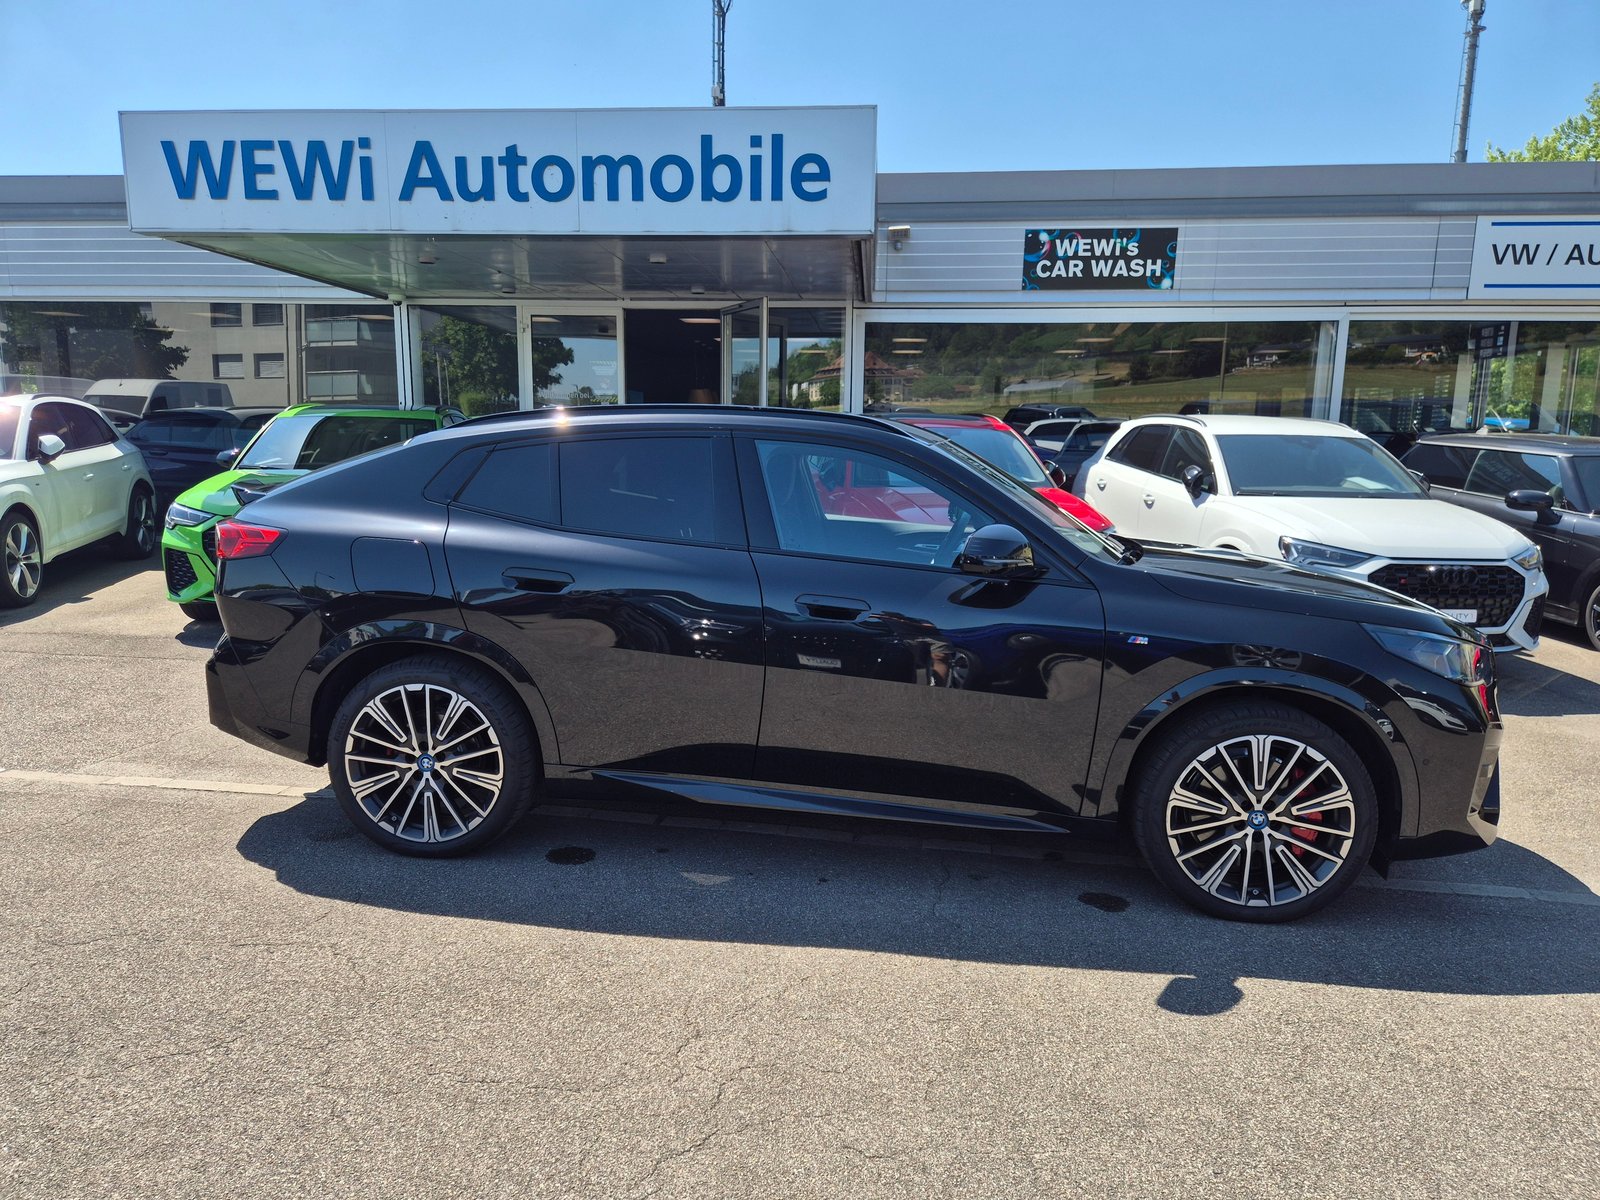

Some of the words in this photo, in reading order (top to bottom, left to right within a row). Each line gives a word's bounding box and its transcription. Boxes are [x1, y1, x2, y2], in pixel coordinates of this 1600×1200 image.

[160, 136, 375, 201] WEWi
[398, 133, 832, 203] Automobile
[1055, 237, 1139, 257] WEWi's
[1491, 243, 1541, 266] VW
[1545, 243, 1559, 266] /
[1036, 259, 1084, 278] CAR
[1091, 259, 1162, 278] WASH
